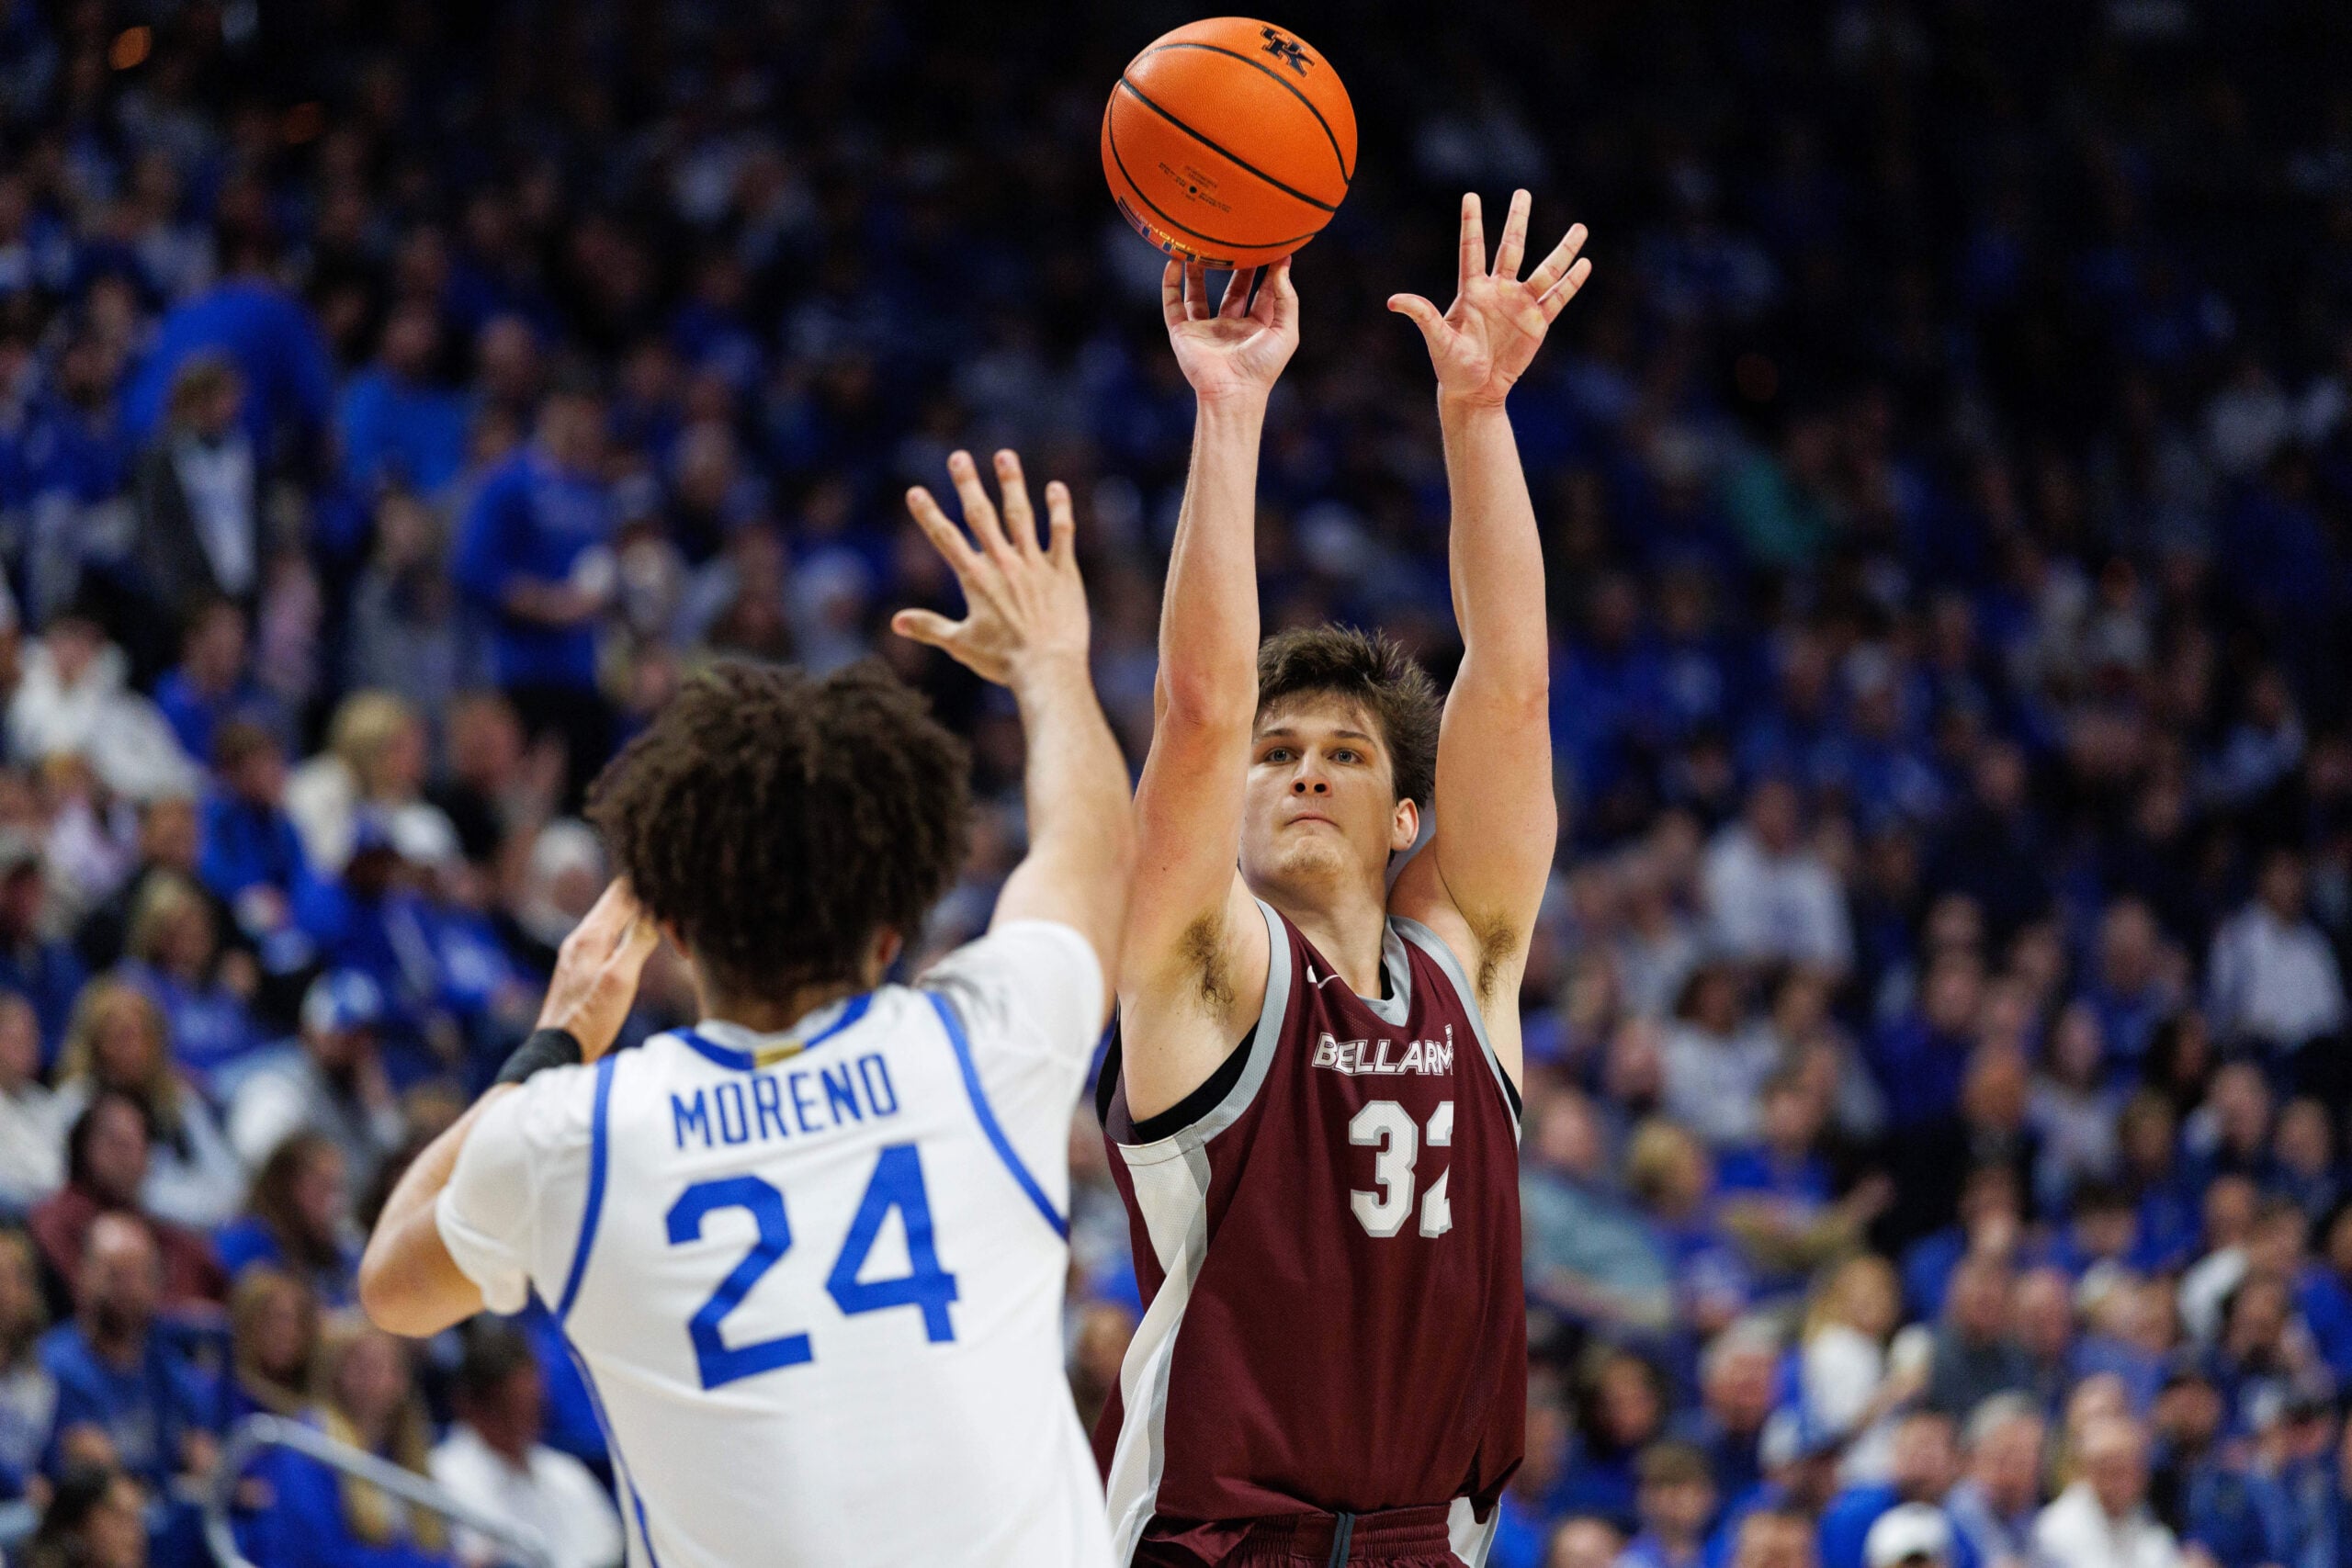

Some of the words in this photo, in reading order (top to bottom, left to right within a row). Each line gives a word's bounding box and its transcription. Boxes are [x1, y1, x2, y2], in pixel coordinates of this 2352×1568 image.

[1312, 1023, 1453, 1076] BELLARM
[671, 1053, 899, 1150] MORENO
[665, 1141, 958, 1391] 24
